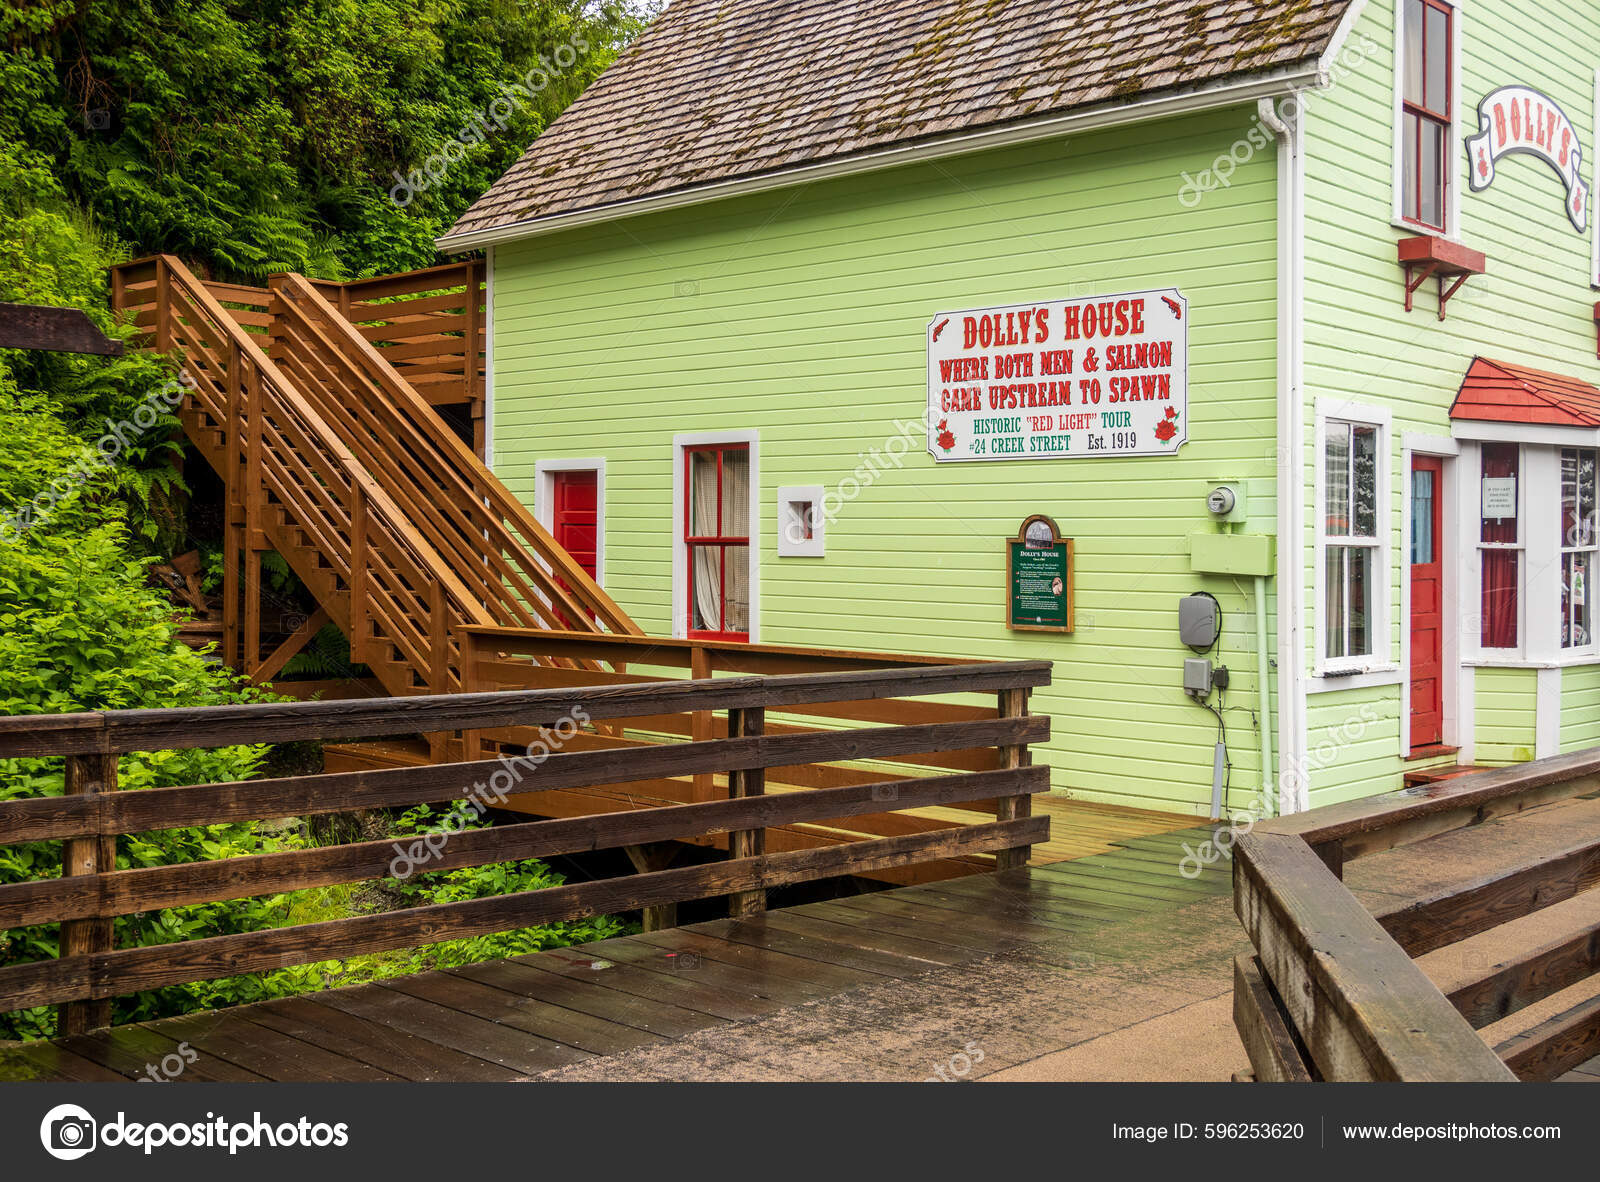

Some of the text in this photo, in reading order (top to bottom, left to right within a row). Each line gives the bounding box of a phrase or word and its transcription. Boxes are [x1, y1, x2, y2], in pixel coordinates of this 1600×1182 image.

[1493, 97, 1571, 166] DOLLY'S
[963, 298, 1145, 350] DOLLY'S HOUSE
[939, 341, 1173, 383] WHERE BOTH MEN & SALMON
[941, 374, 1171, 413] CAME UPSTREAM TO SPAWN
[973, 416, 1021, 435] HISTORIC
[1101, 411, 1132, 428] TOUR
[1088, 432, 1137, 450] Est. 1919
[969, 434, 1071, 454] #24 CREEK STREET
